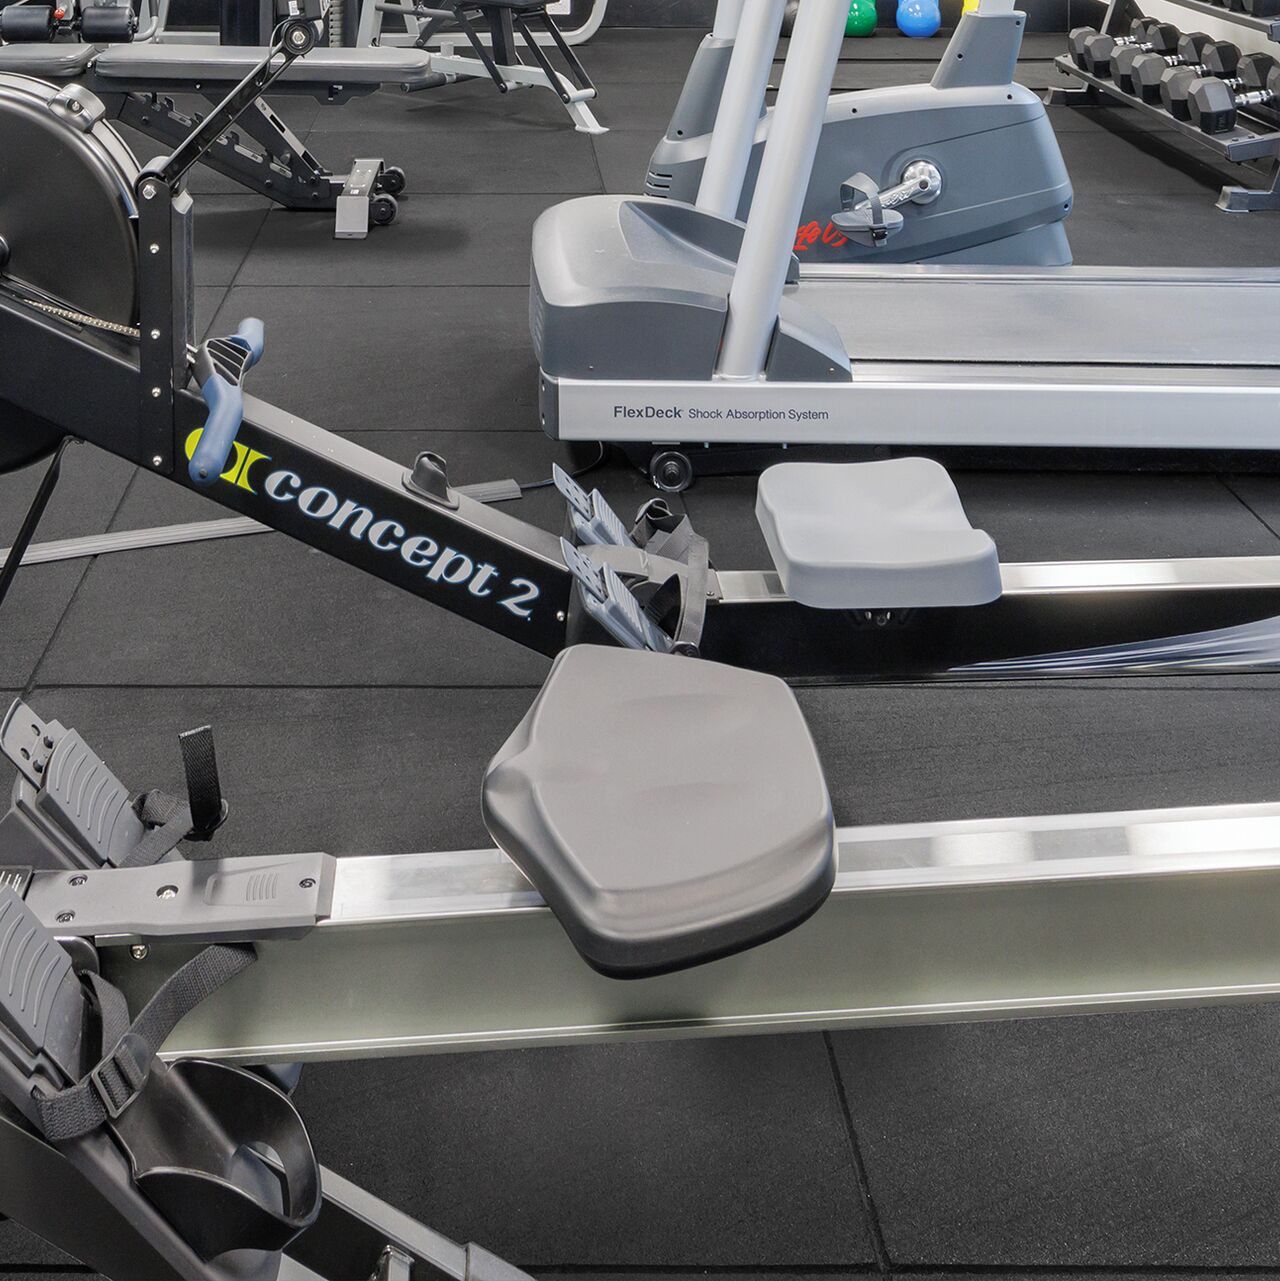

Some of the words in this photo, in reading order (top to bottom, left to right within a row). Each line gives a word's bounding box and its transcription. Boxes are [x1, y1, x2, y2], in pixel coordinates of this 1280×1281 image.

[613, 405, 682, 419] FlexDeck
[688, 408, 723, 420] Shock
[726, 408, 786, 422] Absorption
[788, 408, 829, 422] System
[264, 470, 500, 596] concept
[498, 577, 540, 617] 2
